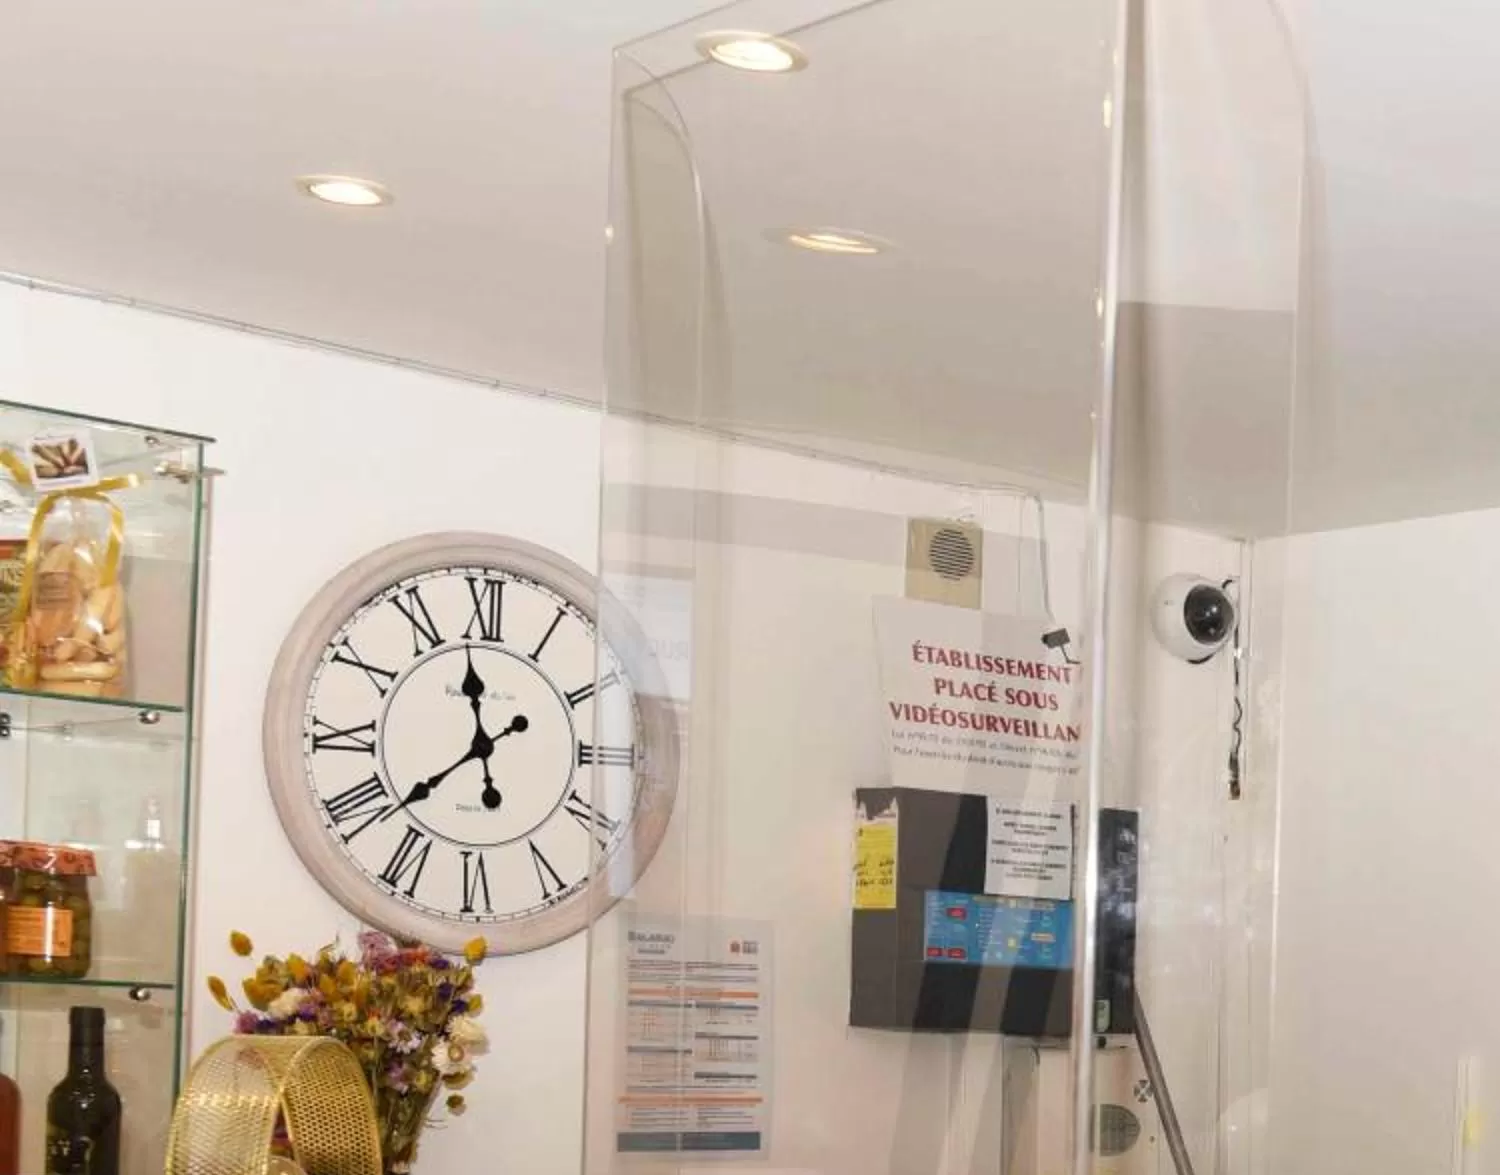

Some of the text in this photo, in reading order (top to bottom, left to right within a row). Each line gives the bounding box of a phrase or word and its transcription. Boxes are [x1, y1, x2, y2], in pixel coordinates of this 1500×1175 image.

[388, 586, 445, 657] XI
[460, 577, 506, 642] XII
[528, 606, 567, 662] I
[331, 638, 398, 697] X
[912, 639, 1073, 684] ÉTABLISSEMENT
[889, 702, 1081, 742] VIDÉOSURVEILLAN
[934, 677, 1059, 711] PLACÉ SOUS
[378, 824, 433, 898] VII
[460, 851, 493, 913] VI
[528, 837, 566, 899] V
